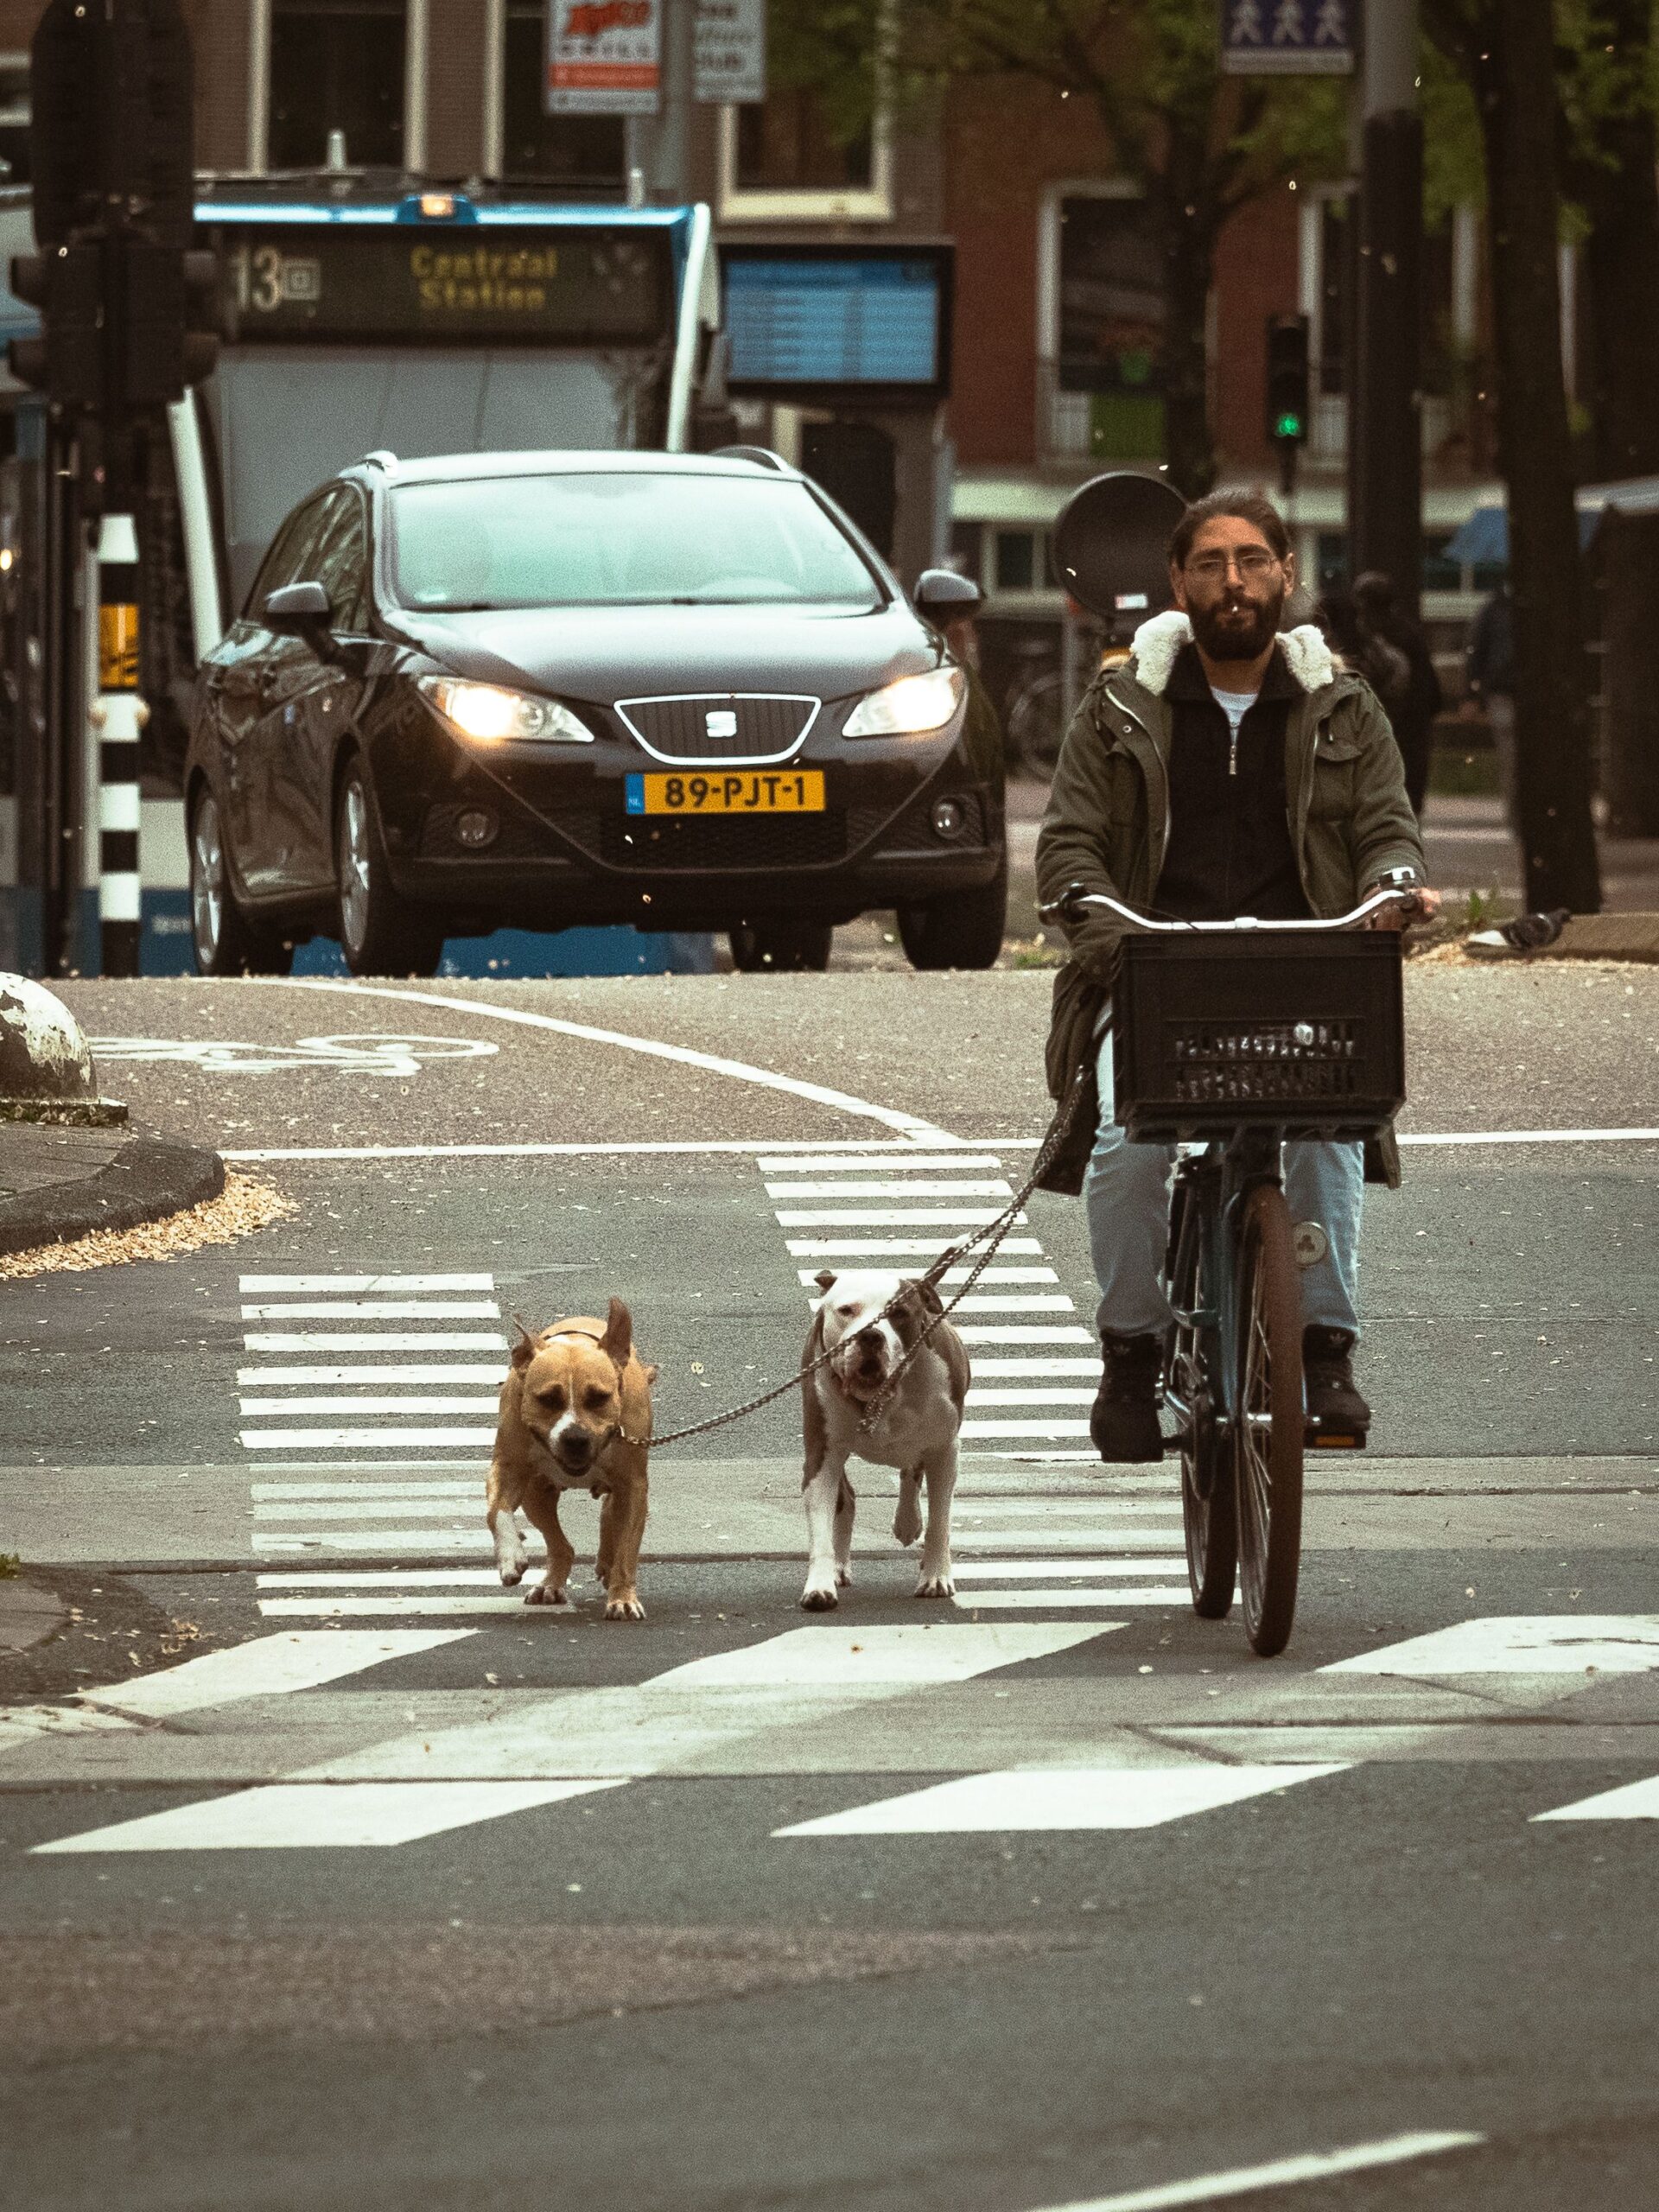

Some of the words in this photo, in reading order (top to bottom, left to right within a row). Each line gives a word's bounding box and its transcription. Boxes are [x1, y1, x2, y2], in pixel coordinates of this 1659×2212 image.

[410, 244, 558, 278] Centraal
[419, 279, 546, 311] Station
[664, 777, 804, 808] 89-PJT-1
